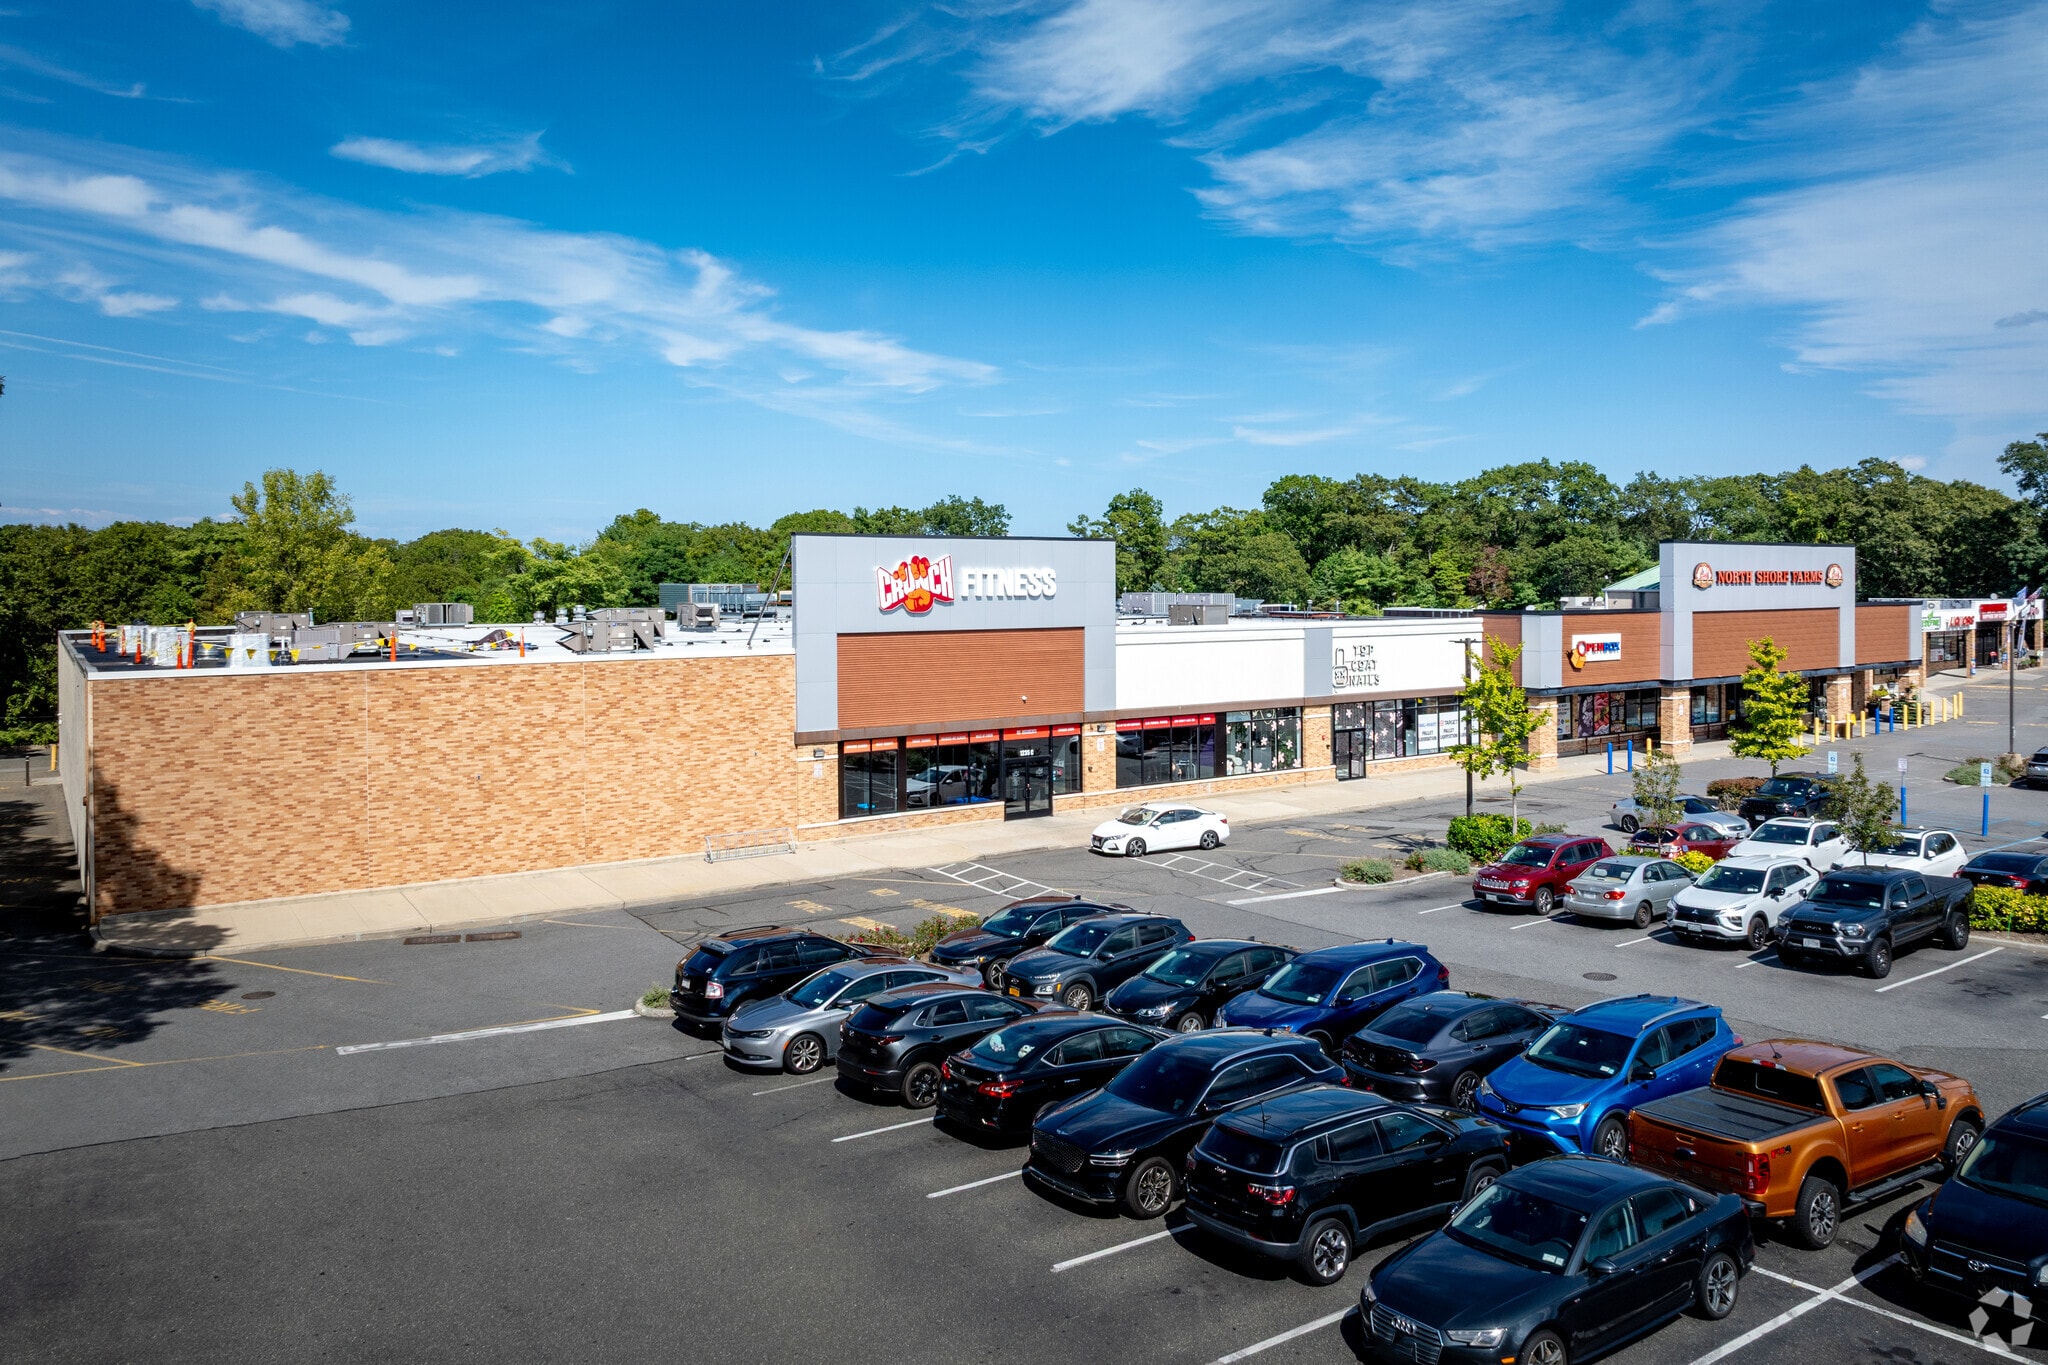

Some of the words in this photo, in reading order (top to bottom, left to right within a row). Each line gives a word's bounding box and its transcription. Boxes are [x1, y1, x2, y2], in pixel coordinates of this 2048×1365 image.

[877, 556, 954, 609] CRUNCH
[961, 568, 1057, 597] FITNESS
[1717, 570, 1752, 583] NORTH
[1756, 570, 1789, 583] SHORE
[1792, 570, 1823, 583] FARMS
